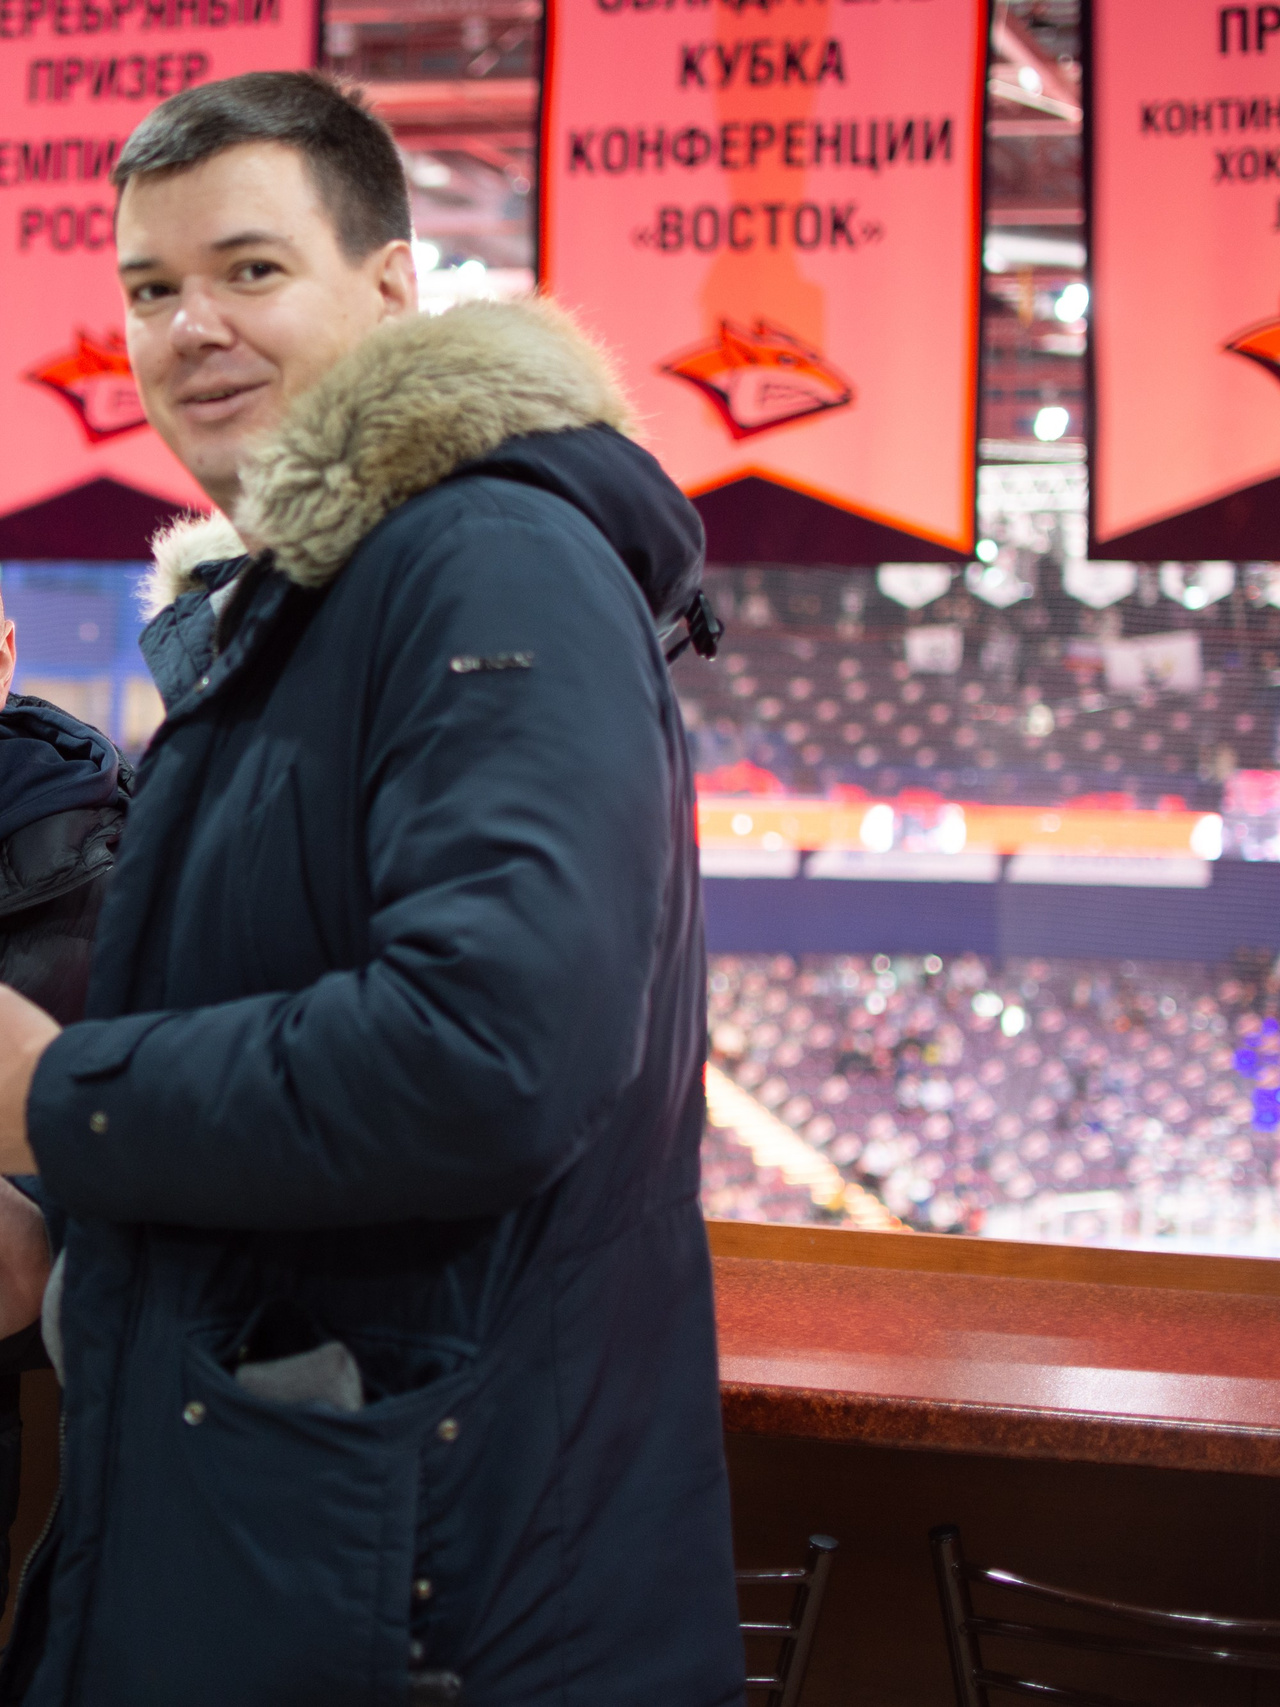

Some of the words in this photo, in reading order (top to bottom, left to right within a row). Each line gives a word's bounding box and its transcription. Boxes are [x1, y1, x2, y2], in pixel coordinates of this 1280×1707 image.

[26, 51, 211, 103] ПРИЗЕР
[680, 38, 846, 88] КУБКА
[567, 117, 955, 175] КОНФЕРЕНЦИИ
[18, 203, 114, 255] РОС
[632, 202, 885, 253] «ВОСТОК»
